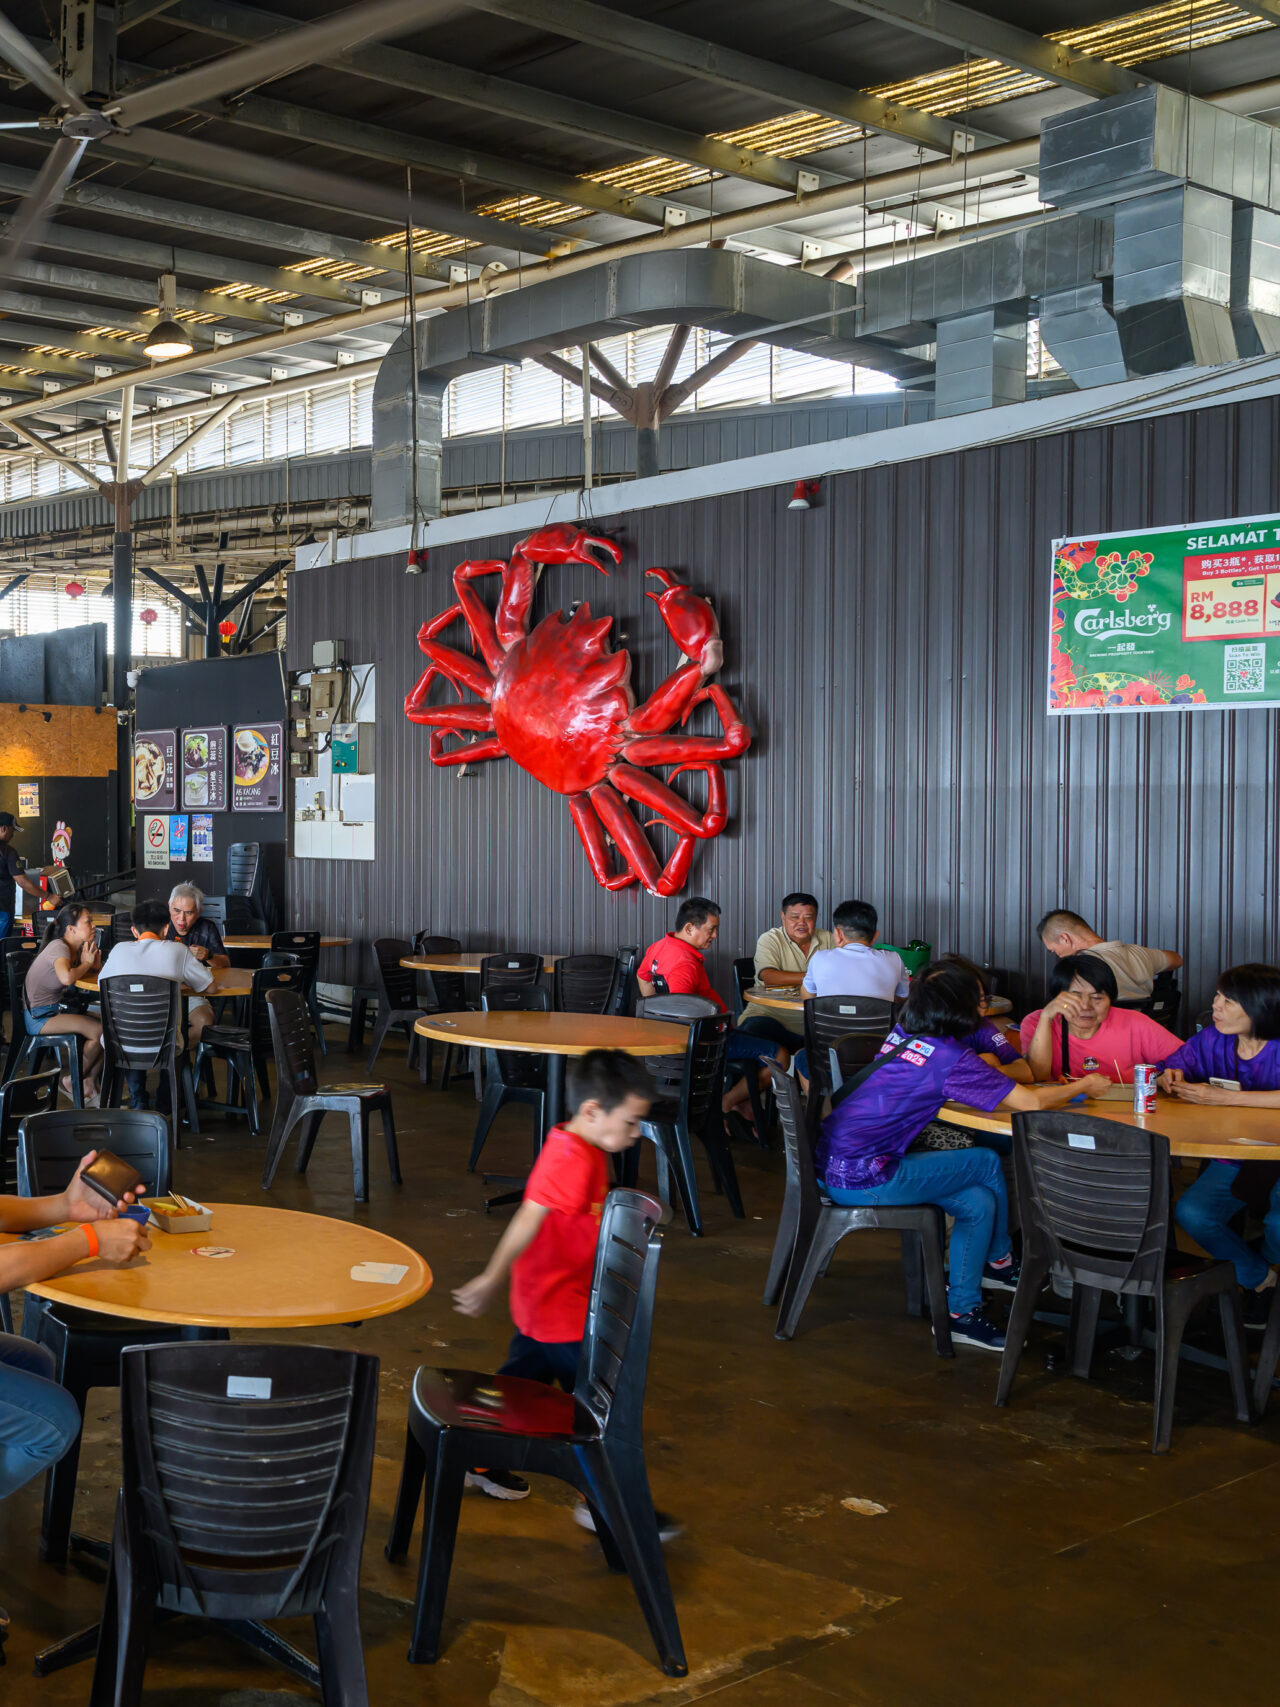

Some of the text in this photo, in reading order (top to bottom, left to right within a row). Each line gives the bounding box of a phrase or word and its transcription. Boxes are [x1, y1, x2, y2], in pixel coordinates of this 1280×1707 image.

[1186, 530, 1268, 550] SELAMAT
[1191, 591, 1214, 603] RM
[1190, 600, 1258, 623] 8,888
[1074, 607, 1172, 640] Carlsberg
[270, 733, 280, 776] 紅豆冰
[243, 787, 261, 796] KACANG
[902, 1050, 924, 1066] 2025
[919, 1045, 931, 1055] PG
